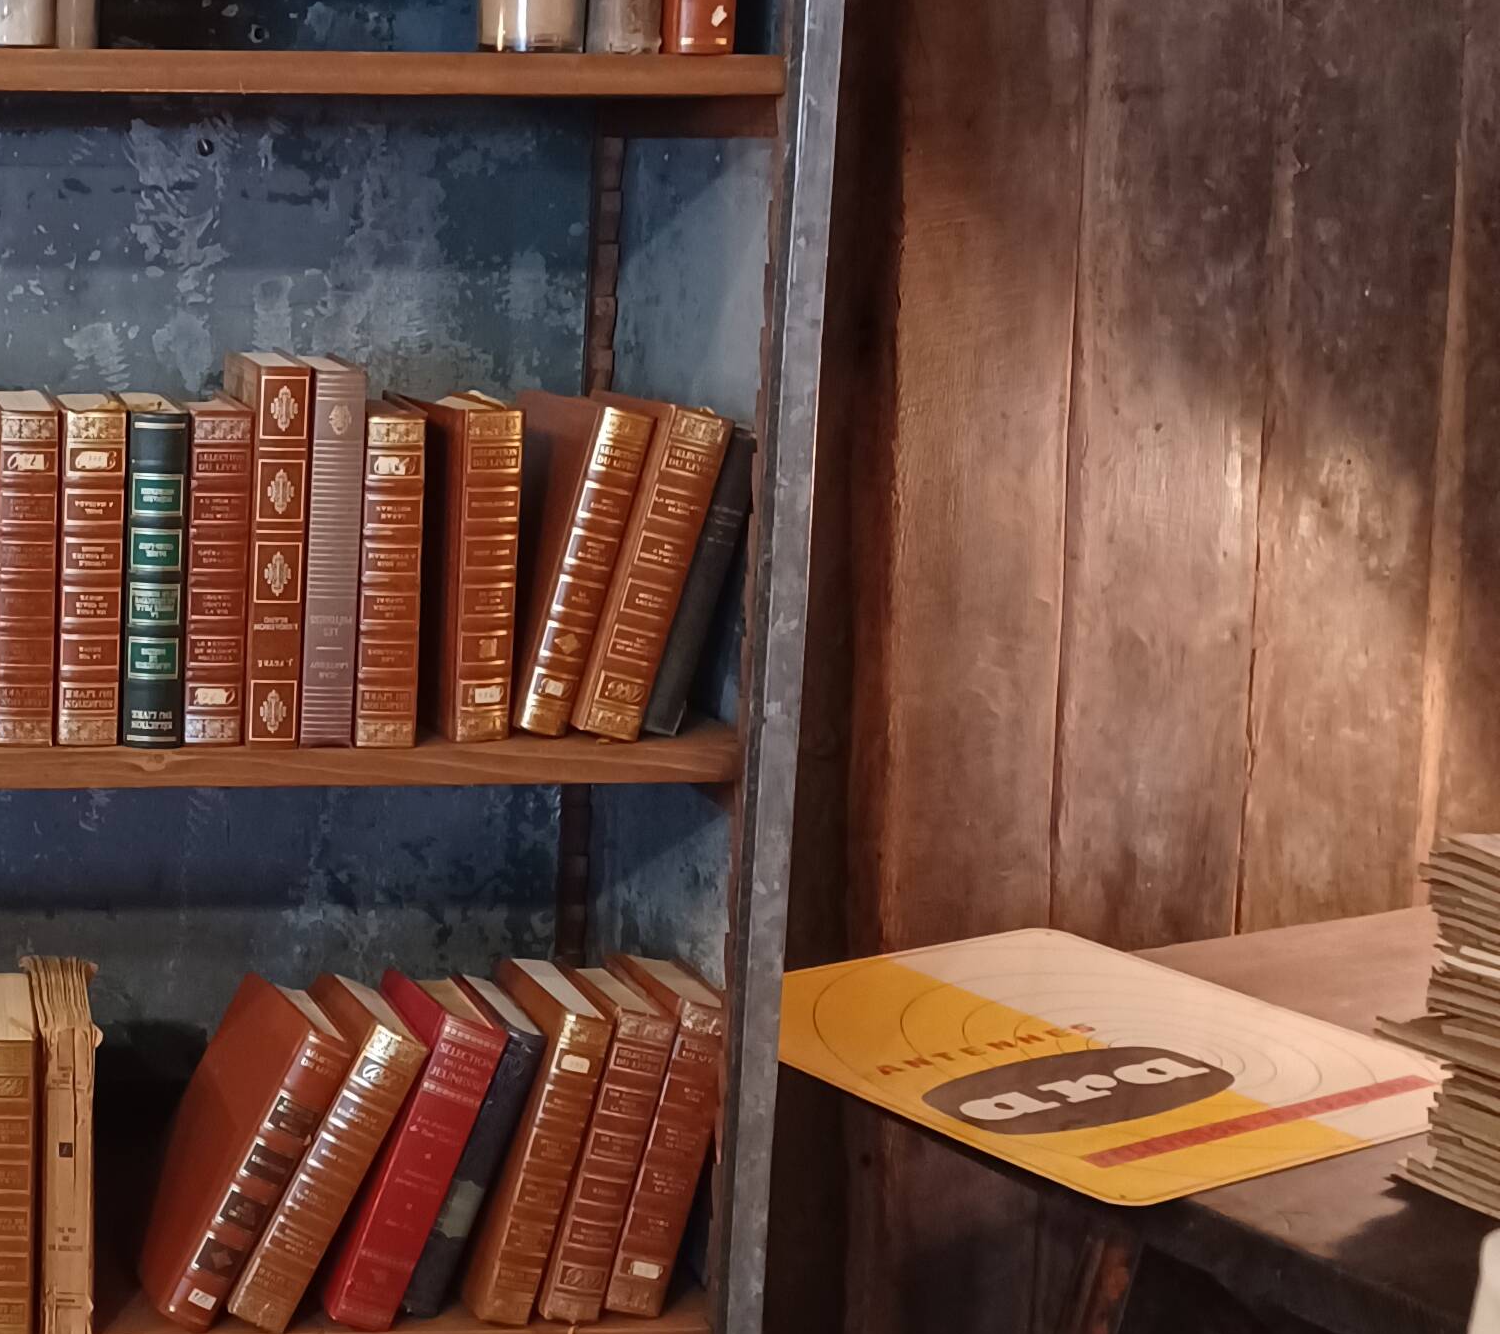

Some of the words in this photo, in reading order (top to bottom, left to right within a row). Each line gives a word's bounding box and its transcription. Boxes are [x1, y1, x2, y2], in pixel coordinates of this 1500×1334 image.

[198, 462, 212, 471] DU
[66, 689, 96, 699] LIVRE
[98, 689, 113, 699] DU
[363, 692, 393, 701] LIVRE
[131, 710, 157, 719] LIVRE
[158, 710, 173, 719] DU
[875, 1023, 1097, 1077] ANTENNES
[438, 1041, 495, 1070] SÉLECTION
[958, 1057, 1211, 1121] ara
